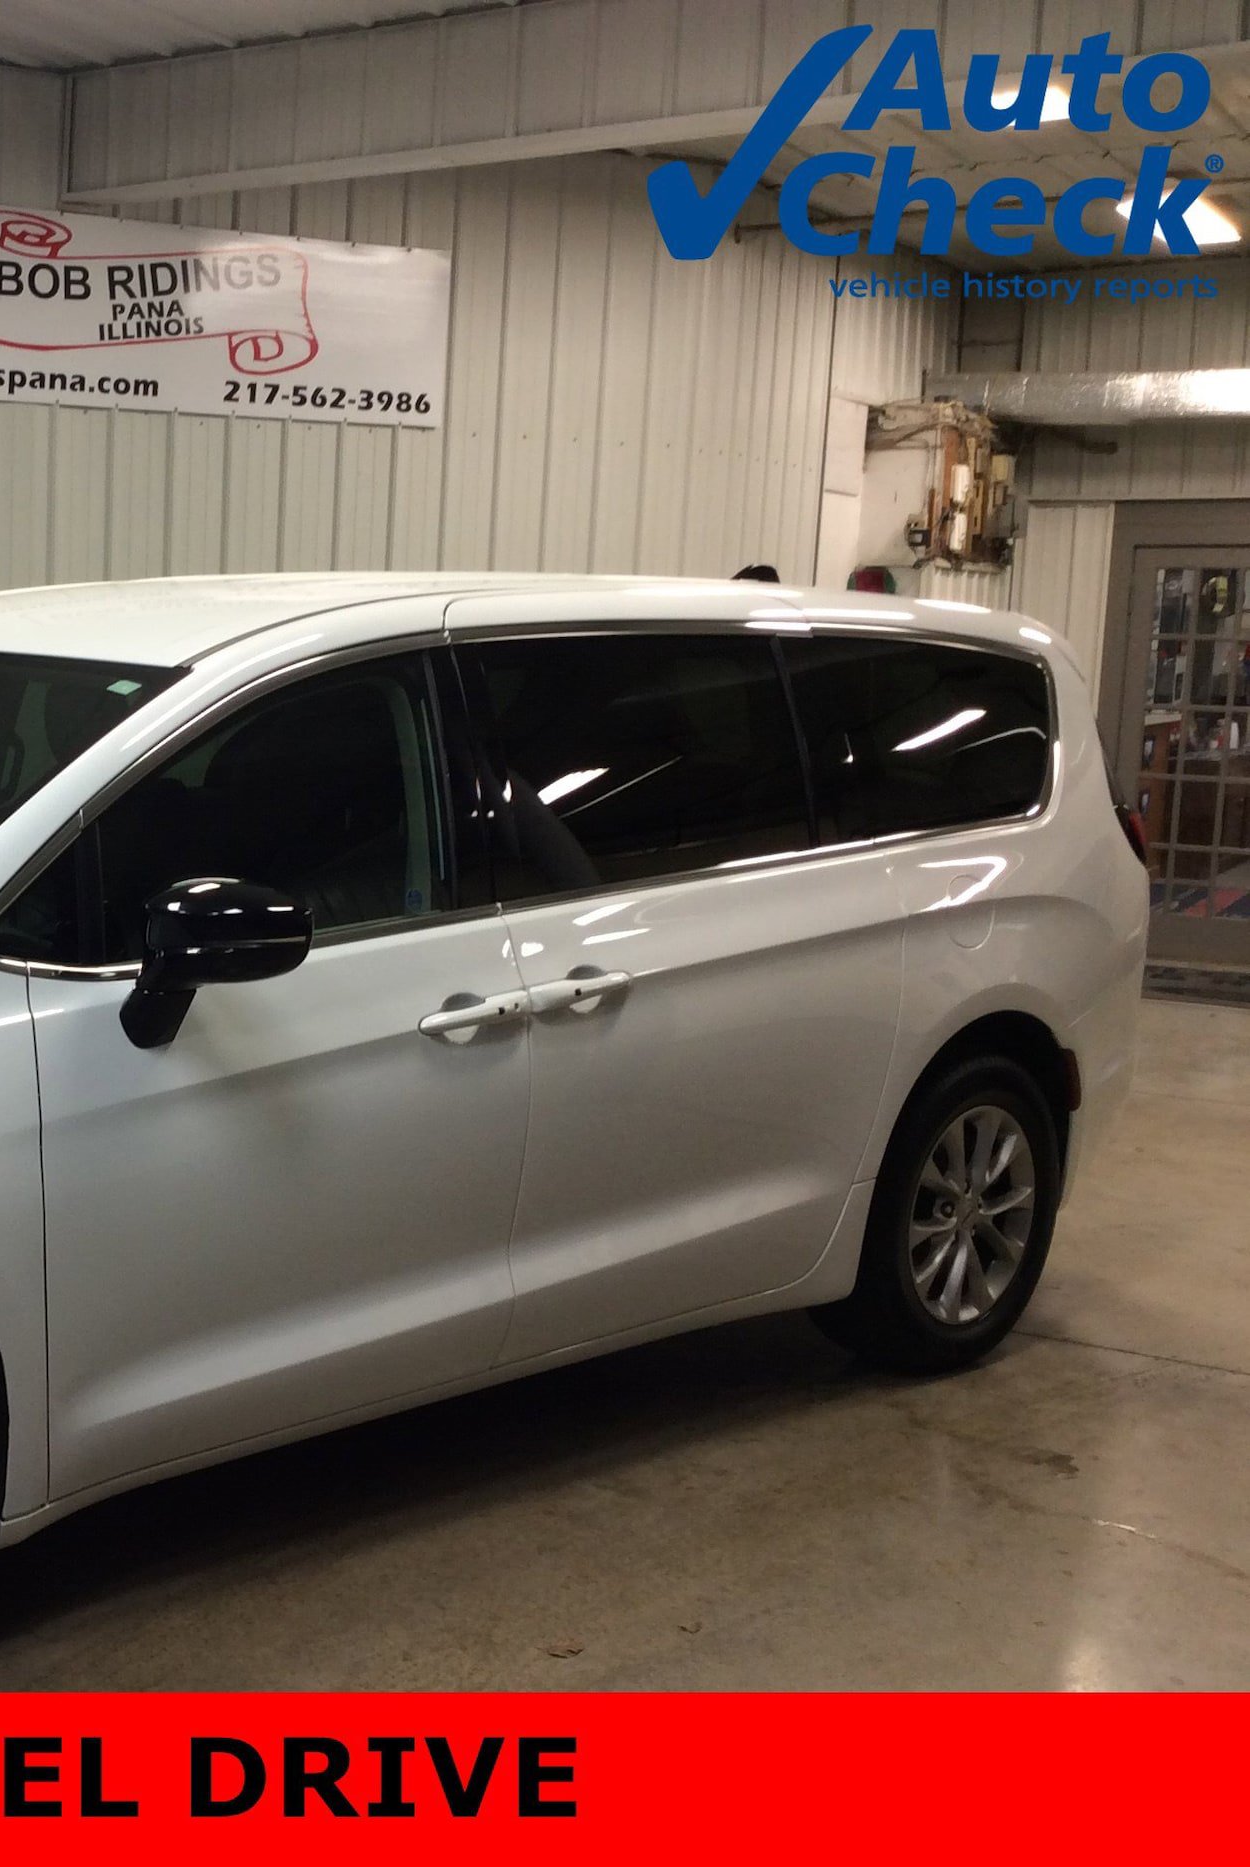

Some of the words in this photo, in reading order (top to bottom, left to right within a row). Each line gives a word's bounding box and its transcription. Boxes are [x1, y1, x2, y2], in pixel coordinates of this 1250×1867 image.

[107, 254, 282, 301] RIDINGS
[111, 300, 184, 323] PANA
[98, 317, 204, 341] ILLINOIS
[223, 380, 431, 415] 217-562-3986
